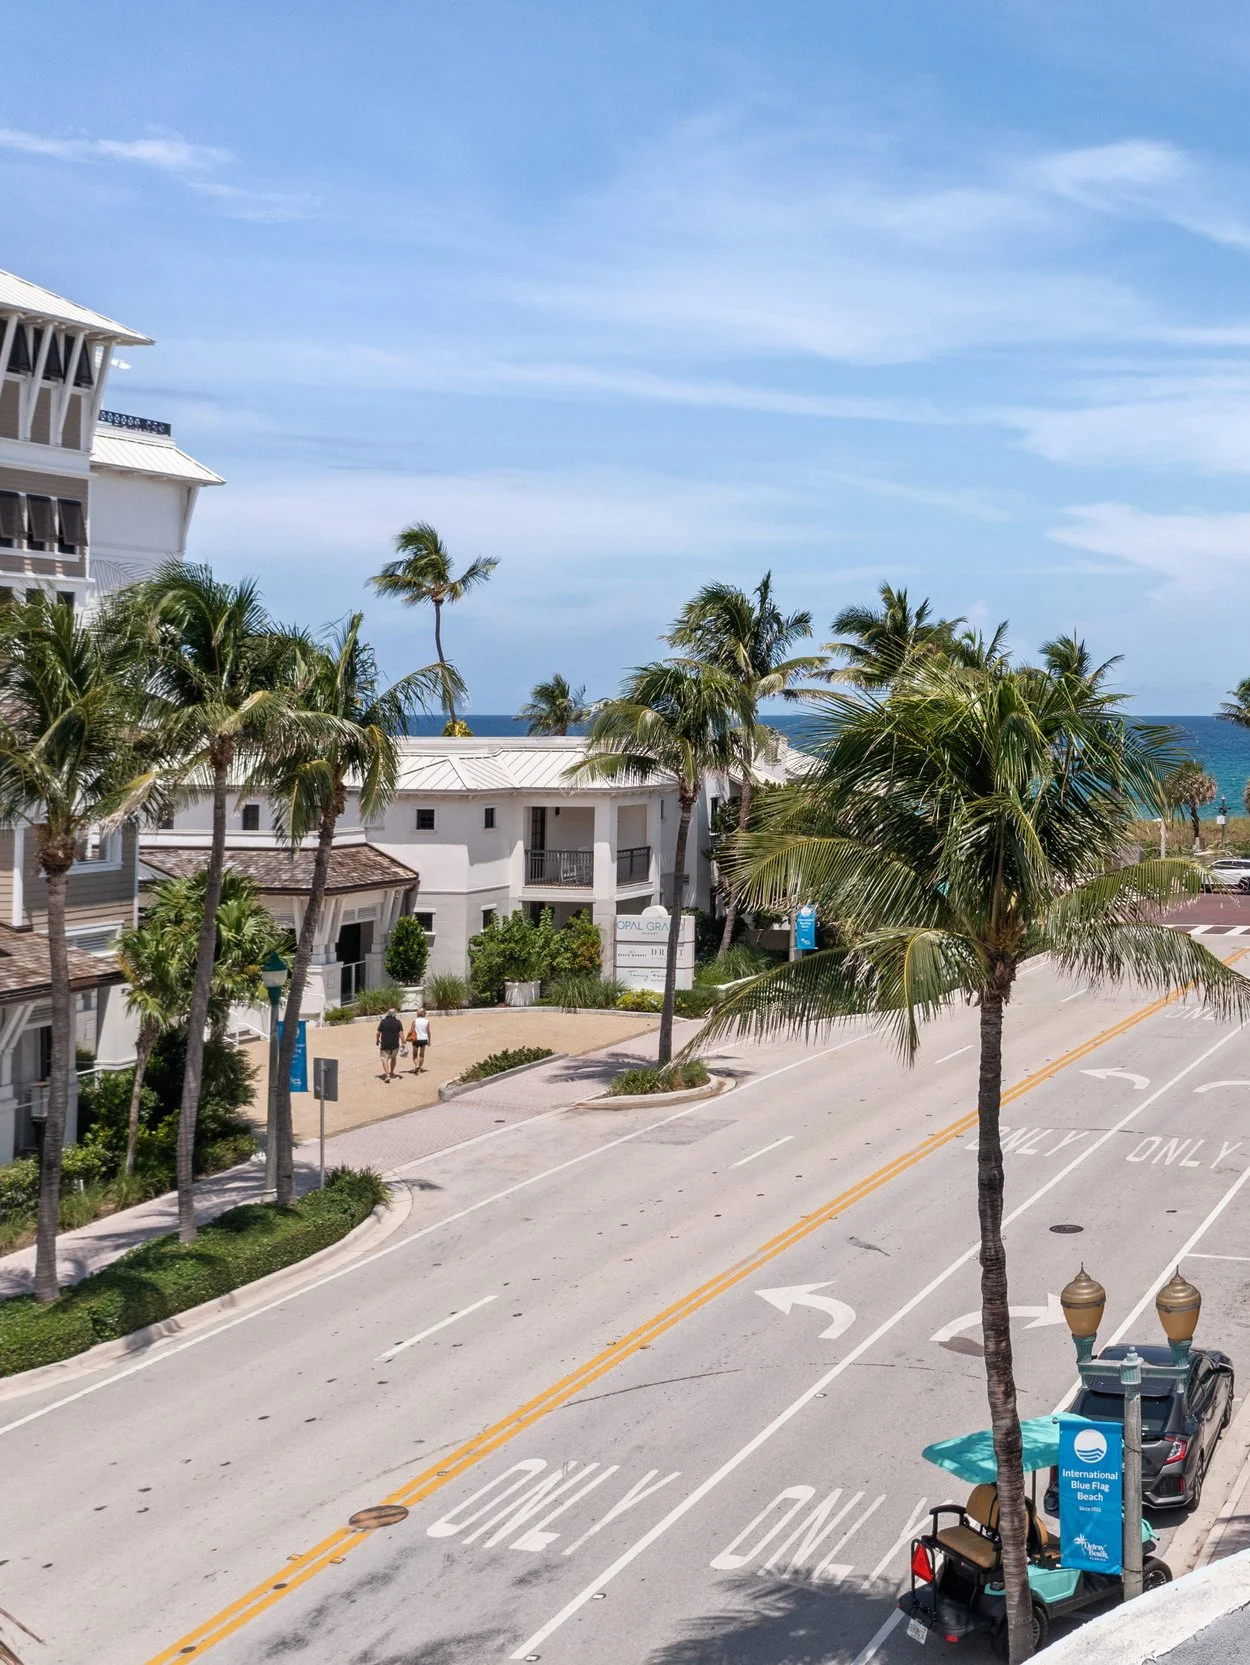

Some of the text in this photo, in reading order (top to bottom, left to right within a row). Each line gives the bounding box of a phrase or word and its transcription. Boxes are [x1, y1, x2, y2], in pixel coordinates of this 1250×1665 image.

[617, 920, 684, 931] OPAL GRAD
[651, 948, 683, 957] DRT
[1164, 1006, 1240, 1020] ONL
[1126, 1136, 1242, 1169] ONLY
[1062, 1469, 1118, 1480] International
[1071, 1480, 1110, 1492] Blue Flag
[1077, 1492, 1103, 1501] Beach
[426, 1458, 682, 1555] ONLY
[709, 1485, 954, 1590] ONLY
